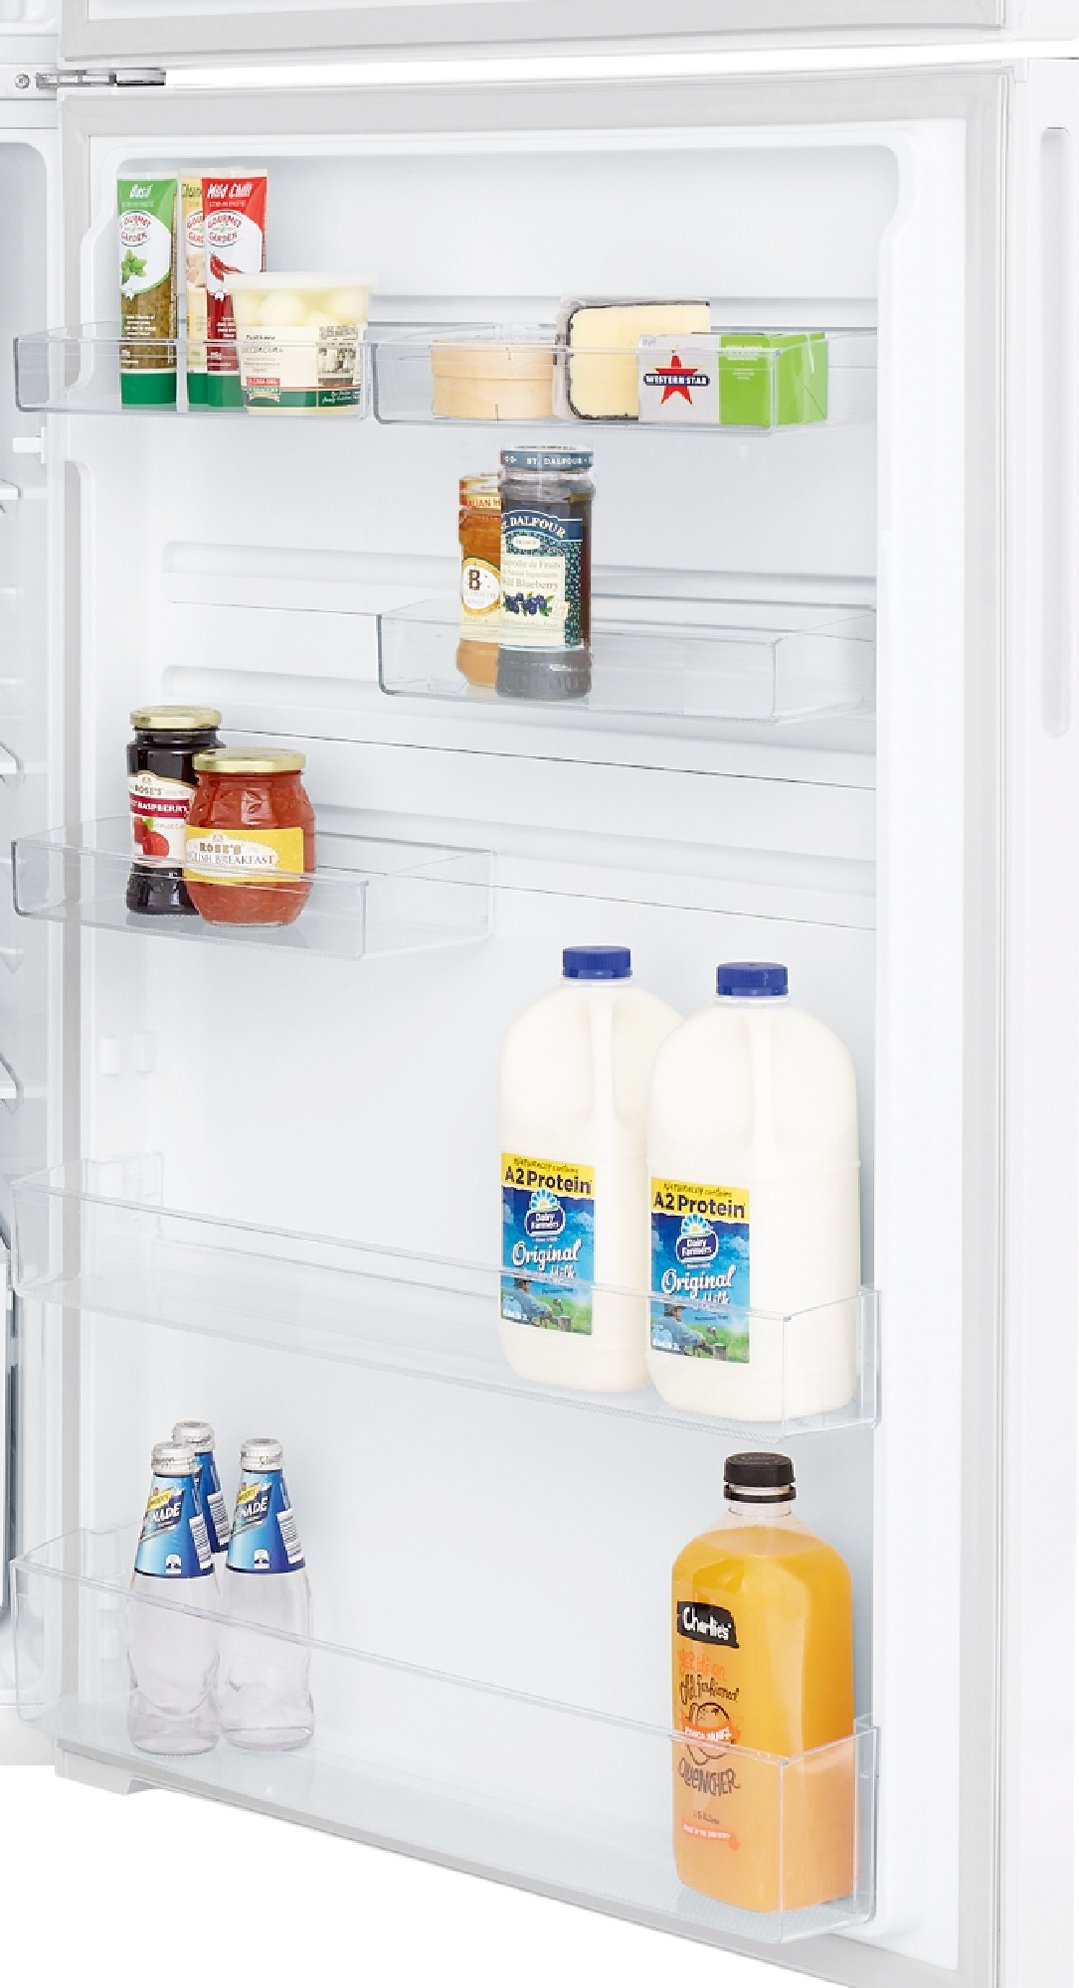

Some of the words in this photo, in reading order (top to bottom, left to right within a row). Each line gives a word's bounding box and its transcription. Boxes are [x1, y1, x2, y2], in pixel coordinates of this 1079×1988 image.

[207, 183, 229, 199] Mild
[207, 214, 242, 229] GOURMET
[645, 375, 685, 385] WESTERN
[686, 376, 707, 385] STAR
[510, 515, 566, 539] DALFOUR
[515, 577, 559, 591] Blueberry
[134, 784, 162, 796] ROSE'S
[137, 800, 187, 812] RASPBERRY
[199, 842, 242, 855] ROSE'S
[215, 853, 274, 865] BREAKFAST
[678, 1194, 745, 1219] Protein
[535, 1212, 556, 1224] Dairy
[530, 1221, 559, 1230] Farmers
[686, 1239, 707, 1249] Dairy
[512, 1238, 583, 1272] Original
[682, 1246, 712, 1257] Farmers
[662, 1264, 737, 1300] Original
